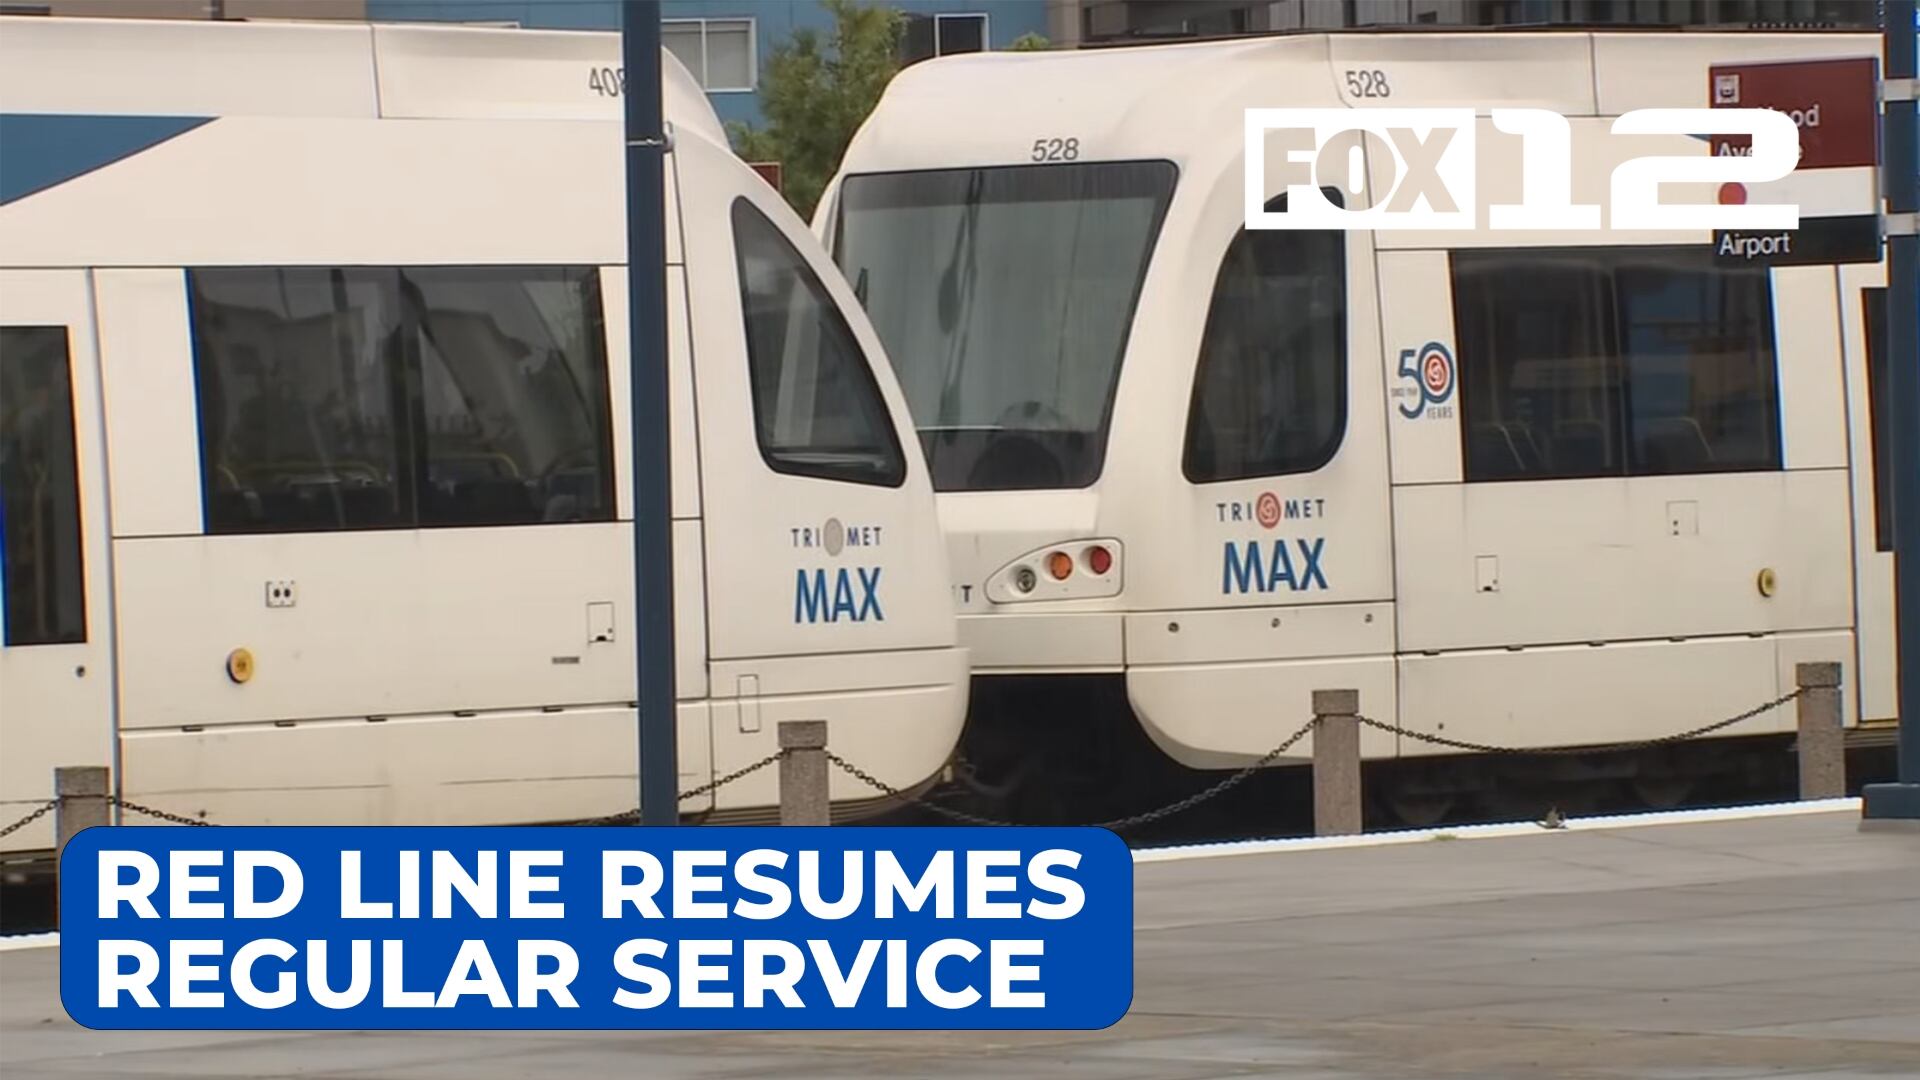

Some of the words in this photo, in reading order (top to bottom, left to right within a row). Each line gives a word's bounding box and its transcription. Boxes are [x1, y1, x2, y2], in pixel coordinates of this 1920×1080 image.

[1345, 70, 1390, 98] 528
[1032, 138, 1079, 161] 528
[1719, 232, 1790, 259] Airport
[1398, 342, 1455, 419] 50
[1223, 538, 1328, 594] MAX
[795, 567, 884, 623] MAX
